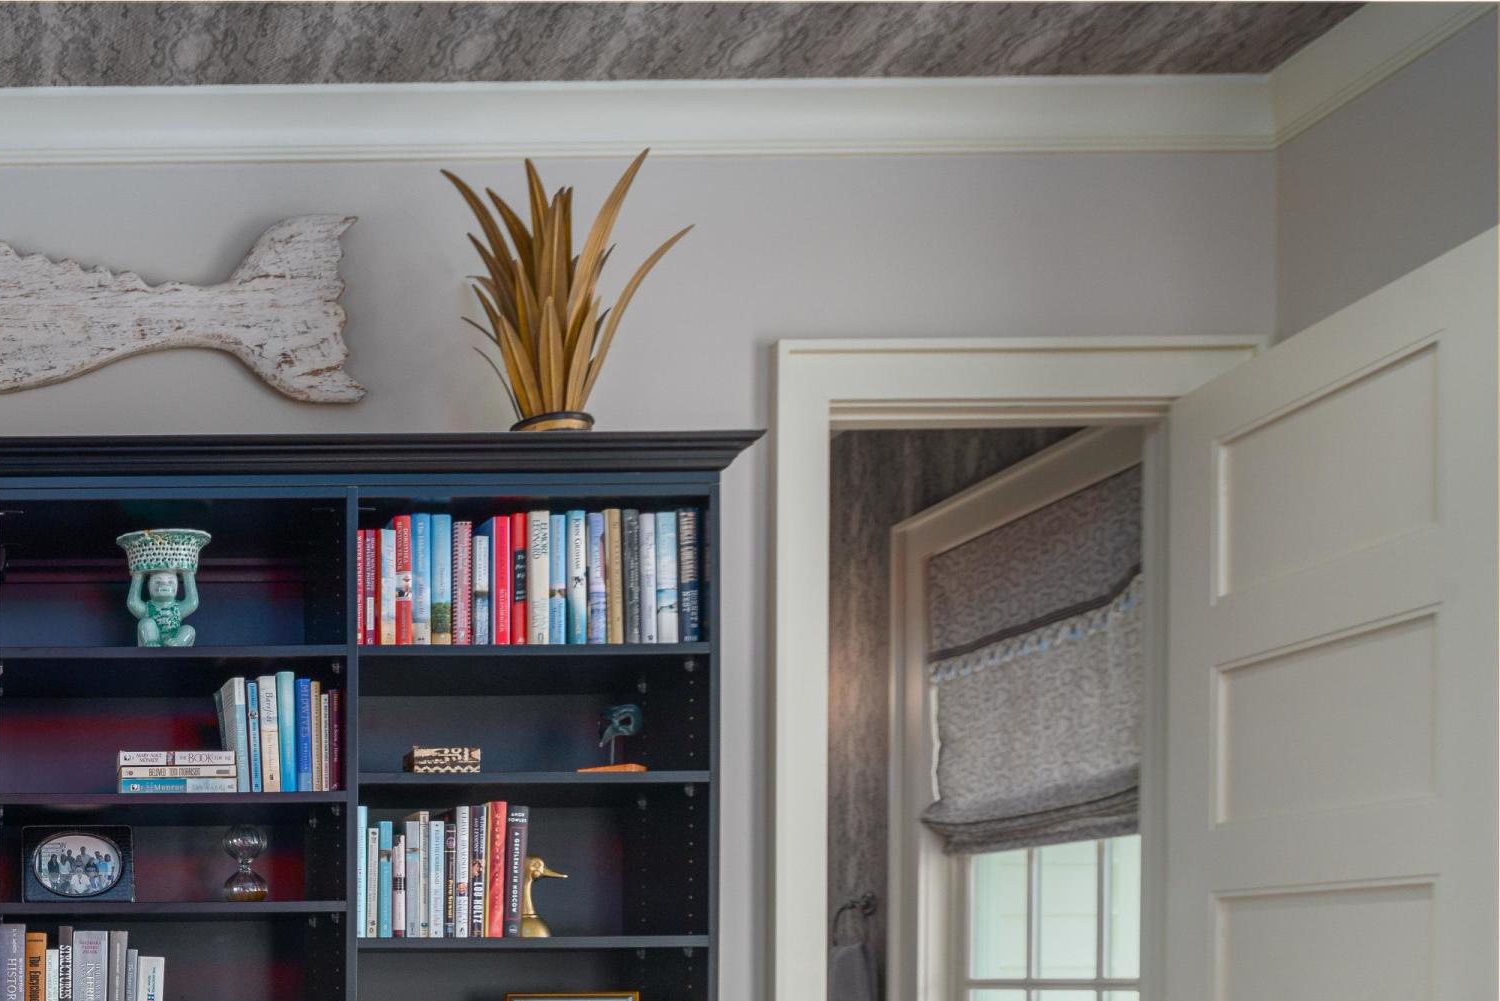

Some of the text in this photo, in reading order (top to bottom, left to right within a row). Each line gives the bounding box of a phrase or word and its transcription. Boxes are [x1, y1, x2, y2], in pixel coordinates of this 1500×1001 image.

[532, 520, 540, 559] LEONARD
[301, 684, 309, 738] MIDWIVES
[188, 753, 213, 763] BOOK
[473, 882, 483, 923] LOU HOLTZ
[29, 956, 41, 967] The
[59, 945, 72, 999] STRUCTURES
